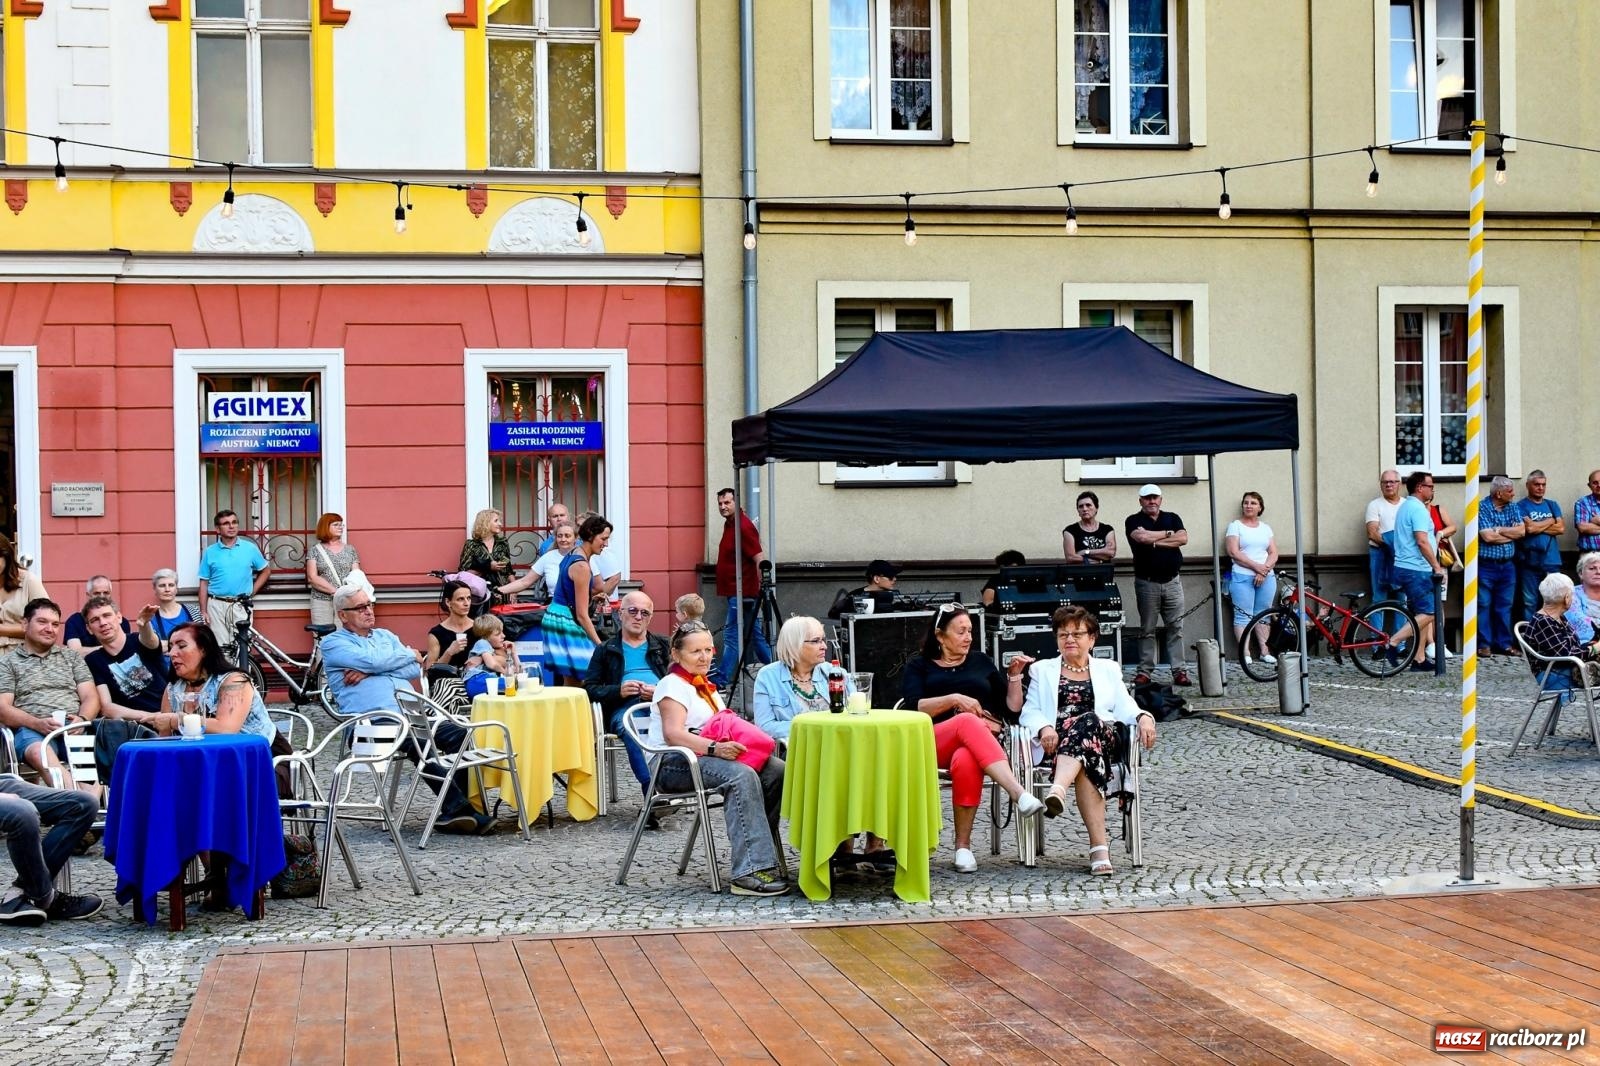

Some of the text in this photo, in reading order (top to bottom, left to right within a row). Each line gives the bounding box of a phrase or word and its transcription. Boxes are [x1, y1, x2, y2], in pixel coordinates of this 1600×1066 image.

[213, 397, 306, 418] AGIMEX
[209, 428, 311, 437] ROZLICZENIE PODATKU
[507, 426, 586, 435] ZASIŁKI RODZINNE
[220, 440, 260, 448] AUSTRIA
[266, 440, 301, 448] NIEMCY
[508, 438, 546, 446] AUSTRIA
[552, 437, 585, 445] NIEMCY
